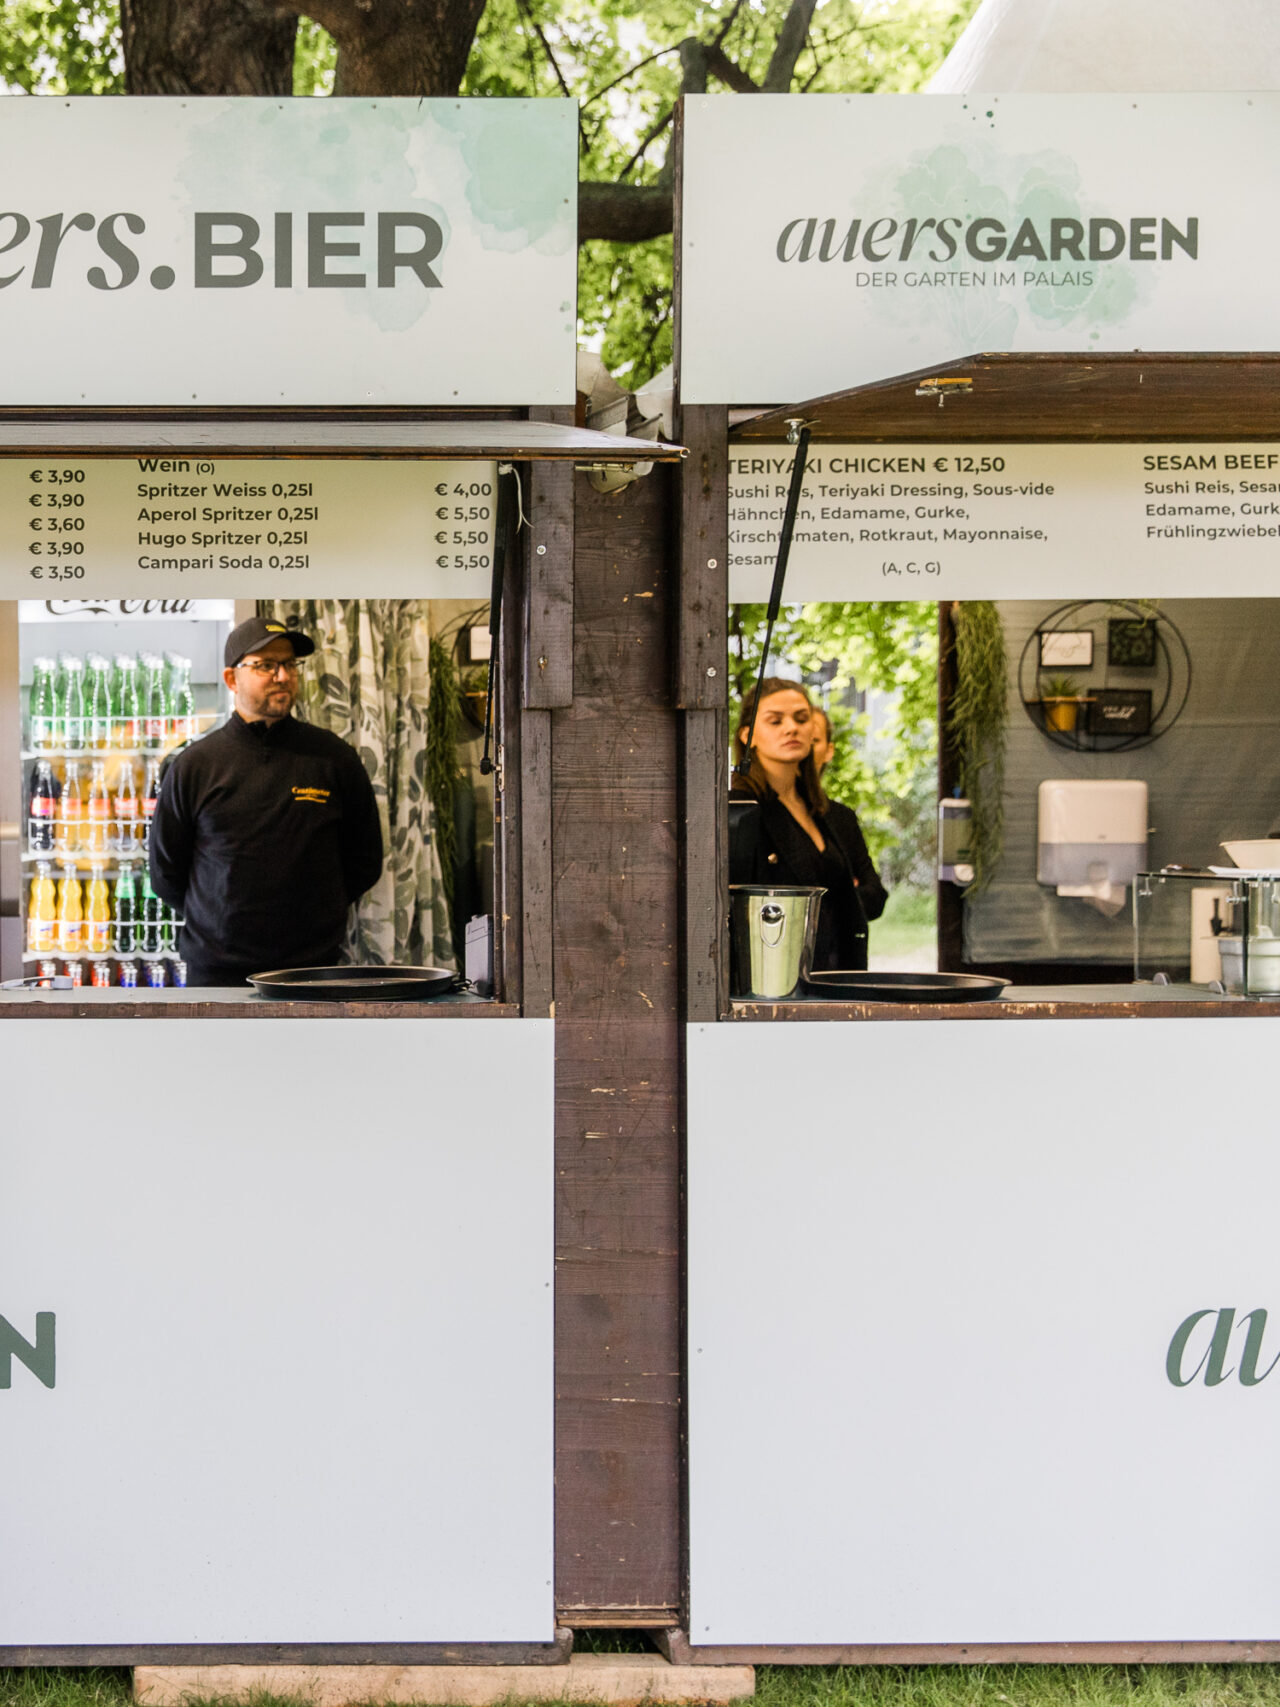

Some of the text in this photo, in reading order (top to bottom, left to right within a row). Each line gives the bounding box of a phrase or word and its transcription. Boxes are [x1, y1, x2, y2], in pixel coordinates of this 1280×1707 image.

[777, 215, 1198, 262] auersGARDEN
[856, 271, 1093, 287] DER GARTEN IM PALAIS
[137, 458, 191, 472] Wein
[830, 458, 925, 473] CHICKEN
[933, 458, 948, 472] €
[955, 457, 1005, 475] 12,50
[1144, 455, 1278, 470] SESAM BEEF
[30, 470, 85, 485] € 3,90
[138, 483, 312, 500] Spritzer Weiss 0,25l
[435, 483, 492, 498] € 4,00
[727, 482, 1054, 500] Sushi Rs, Teriyaki Dressing, Sous-vide
[1145, 481, 1189, 494] Sushi
[1195, 480, 1234, 494] Reis,
[29, 494, 84, 509] € 3,90
[138, 507, 318, 524] Aperol Spritzer 0,25l
[436, 507, 490, 522] € 5,50
[821, 507, 909, 520] Edamame,
[915, 506, 969, 520] Gurke,
[1146, 504, 1235, 516] Edamame,
[29, 518, 84, 533] € 3,60
[139, 531, 307, 548] Hugo Spritzer 0,25l
[435, 531, 488, 546] € 5,50
[860, 529, 937, 542] Rotkraut,
[944, 527, 1047, 543] Mayonnaise,
[29, 542, 84, 557] € 3,90
[138, 555, 309, 572] Campari Soda 0,25l
[436, 555, 489, 570] € 5,50
[883, 562, 940, 576] (A, C, G)
[30, 566, 85, 581] € 3,50
